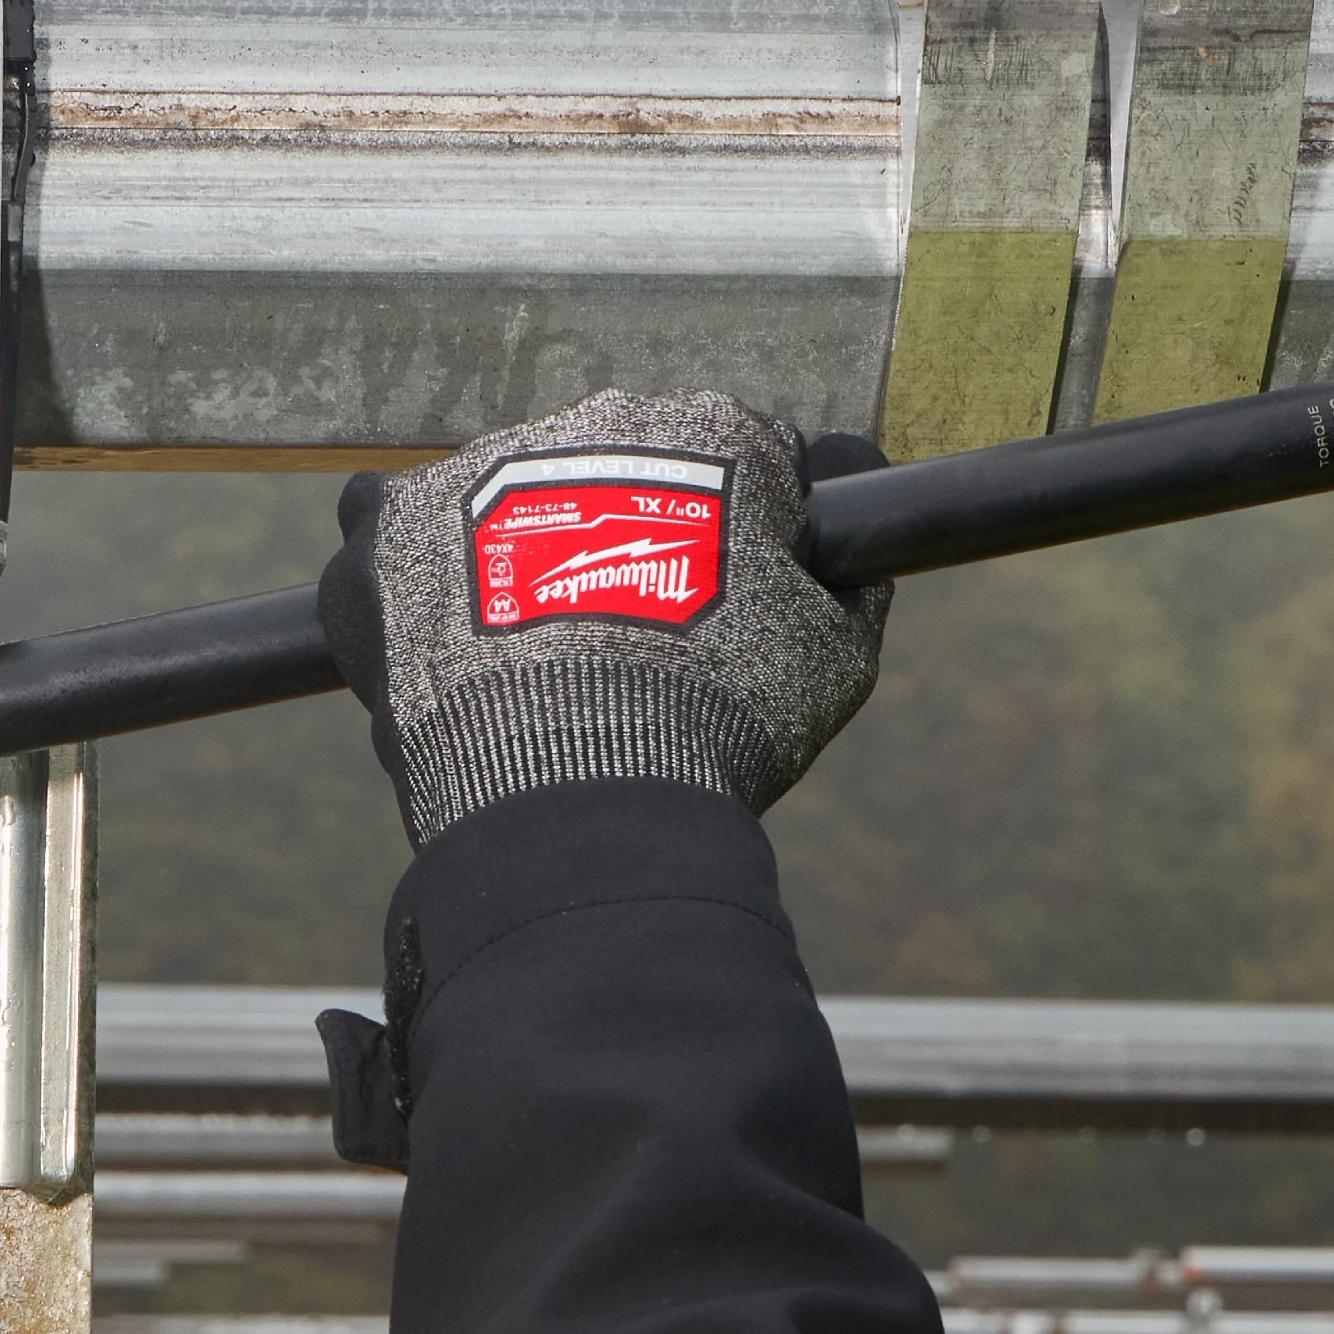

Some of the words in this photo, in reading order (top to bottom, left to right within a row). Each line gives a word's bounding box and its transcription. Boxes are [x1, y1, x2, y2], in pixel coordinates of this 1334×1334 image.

[1307, 405, 1330, 467] TORQUE
[540, 464, 553, 476] 4
[562, 460, 635, 476] LEVEL
[640, 462, 688, 478] CUT
[513, 501, 578, 515] 48-73-7143
[631, 496, 662, 514] XL
[534, 555, 699, 604] Milwaukee
[493, 598, 511, 612] A4
